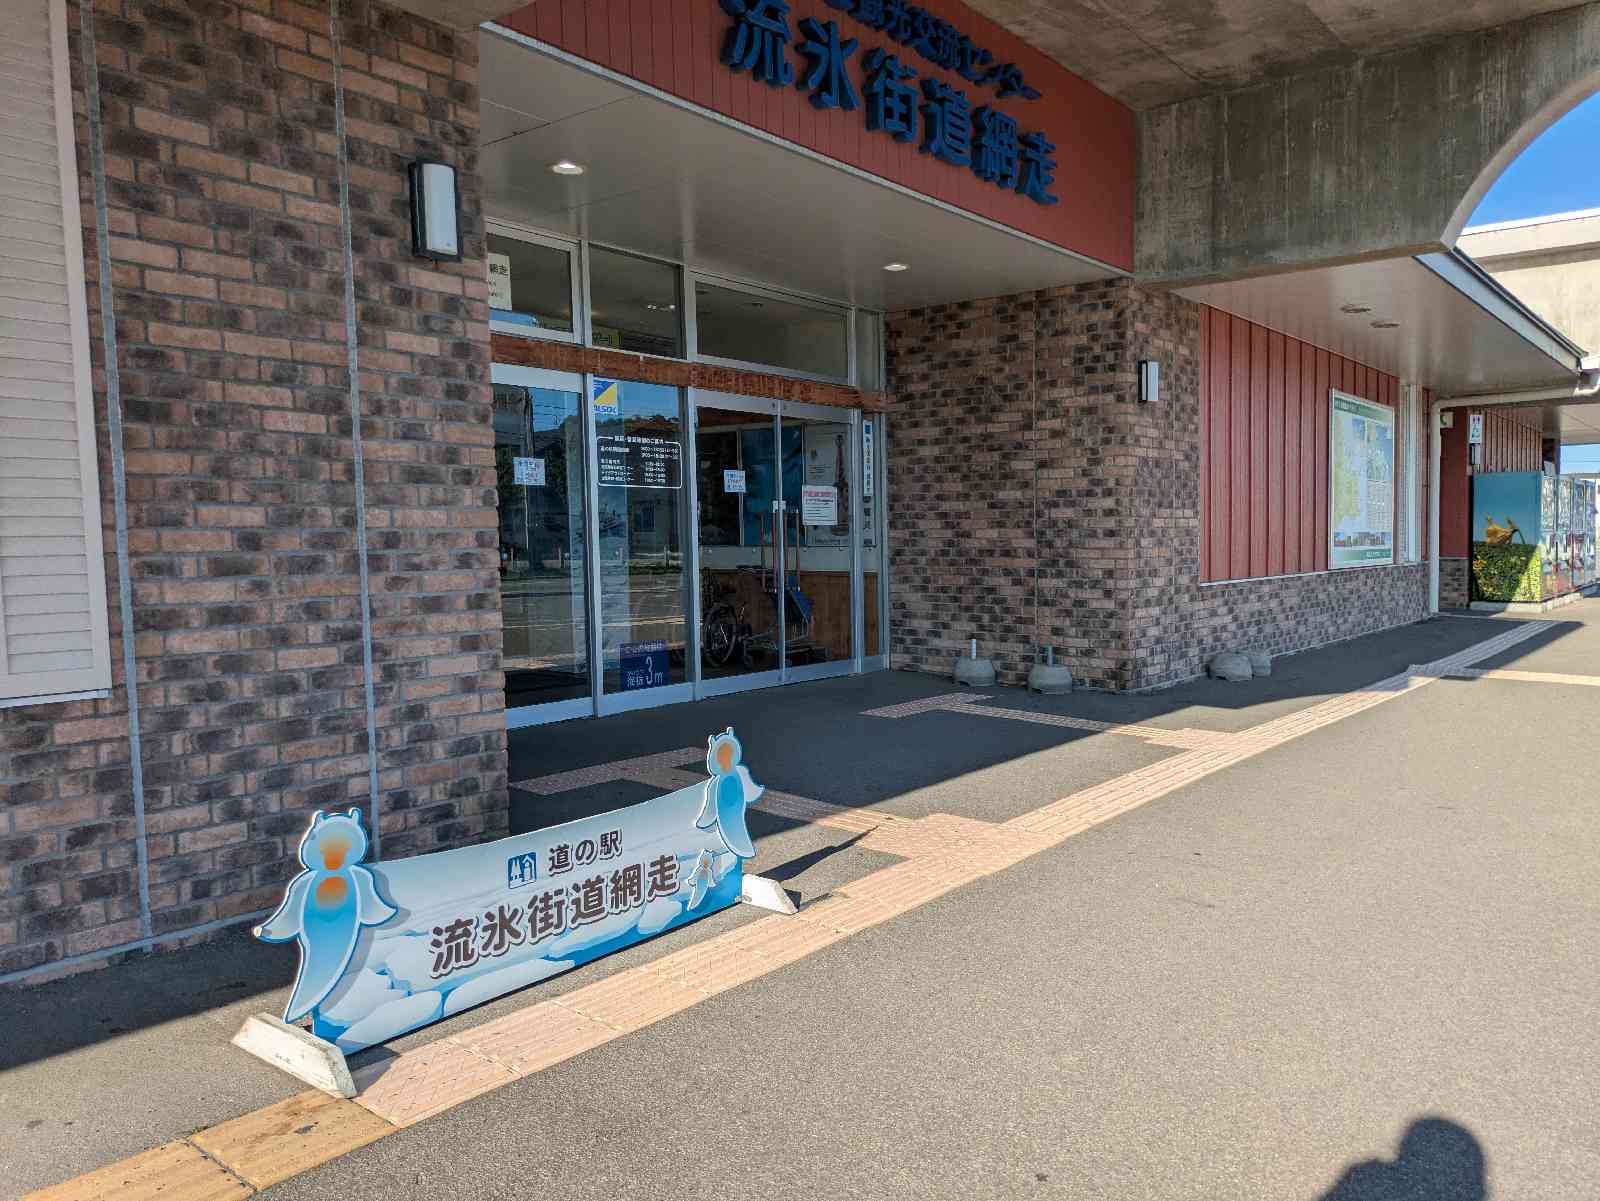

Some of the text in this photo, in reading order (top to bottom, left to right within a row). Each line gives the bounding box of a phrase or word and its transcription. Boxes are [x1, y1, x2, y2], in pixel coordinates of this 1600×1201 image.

[720, 0, 1060, 206] 流氷街道網走
[548, 829, 622, 873] 道の駅
[430, 854, 679, 974] 流氷街道網走
